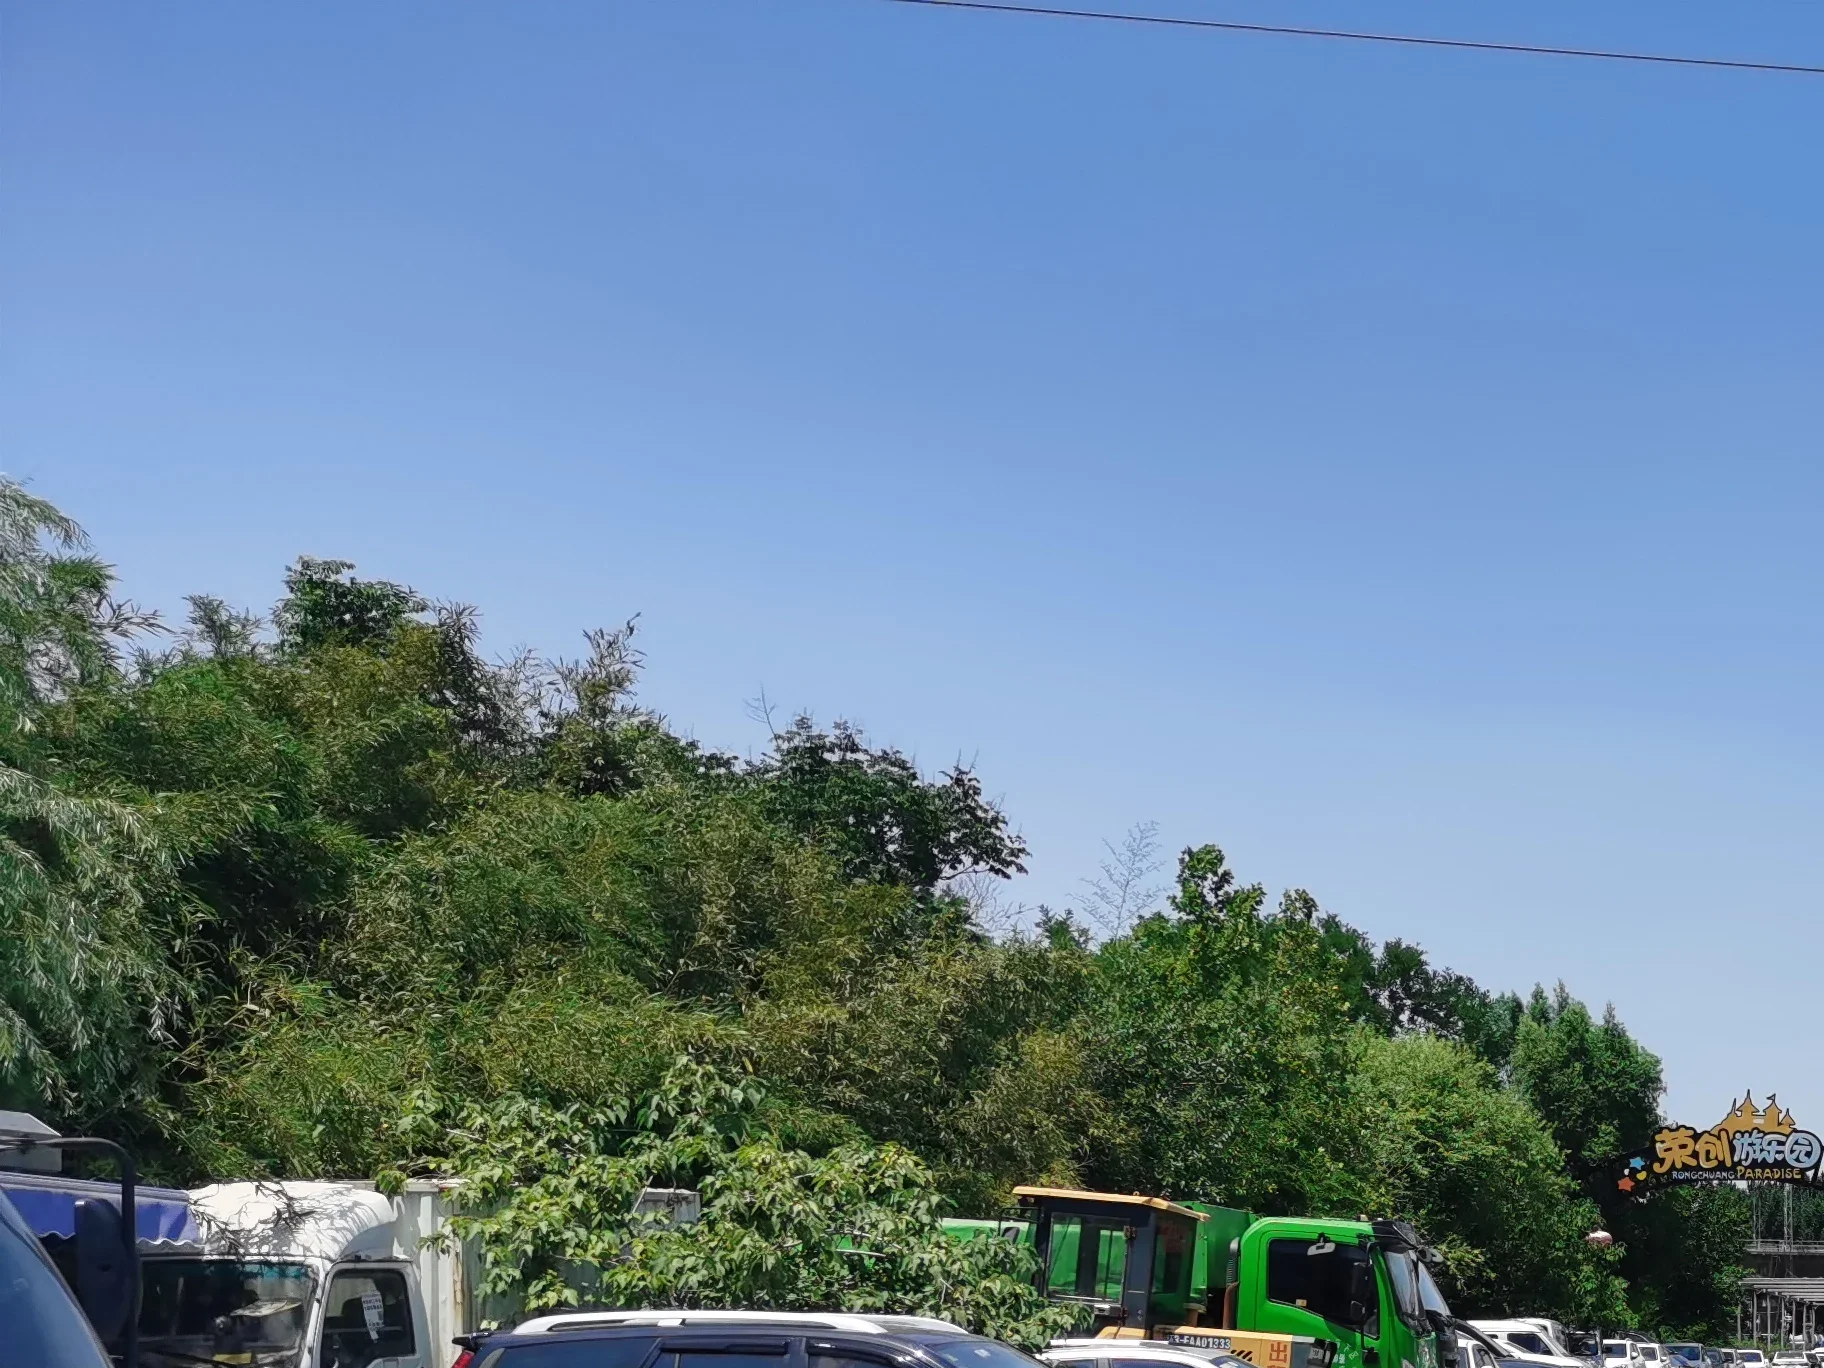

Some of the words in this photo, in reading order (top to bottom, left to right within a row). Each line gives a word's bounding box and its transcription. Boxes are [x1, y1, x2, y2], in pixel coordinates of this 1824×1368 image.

[1653, 1127, 1821, 1173] 荣创游乐园
